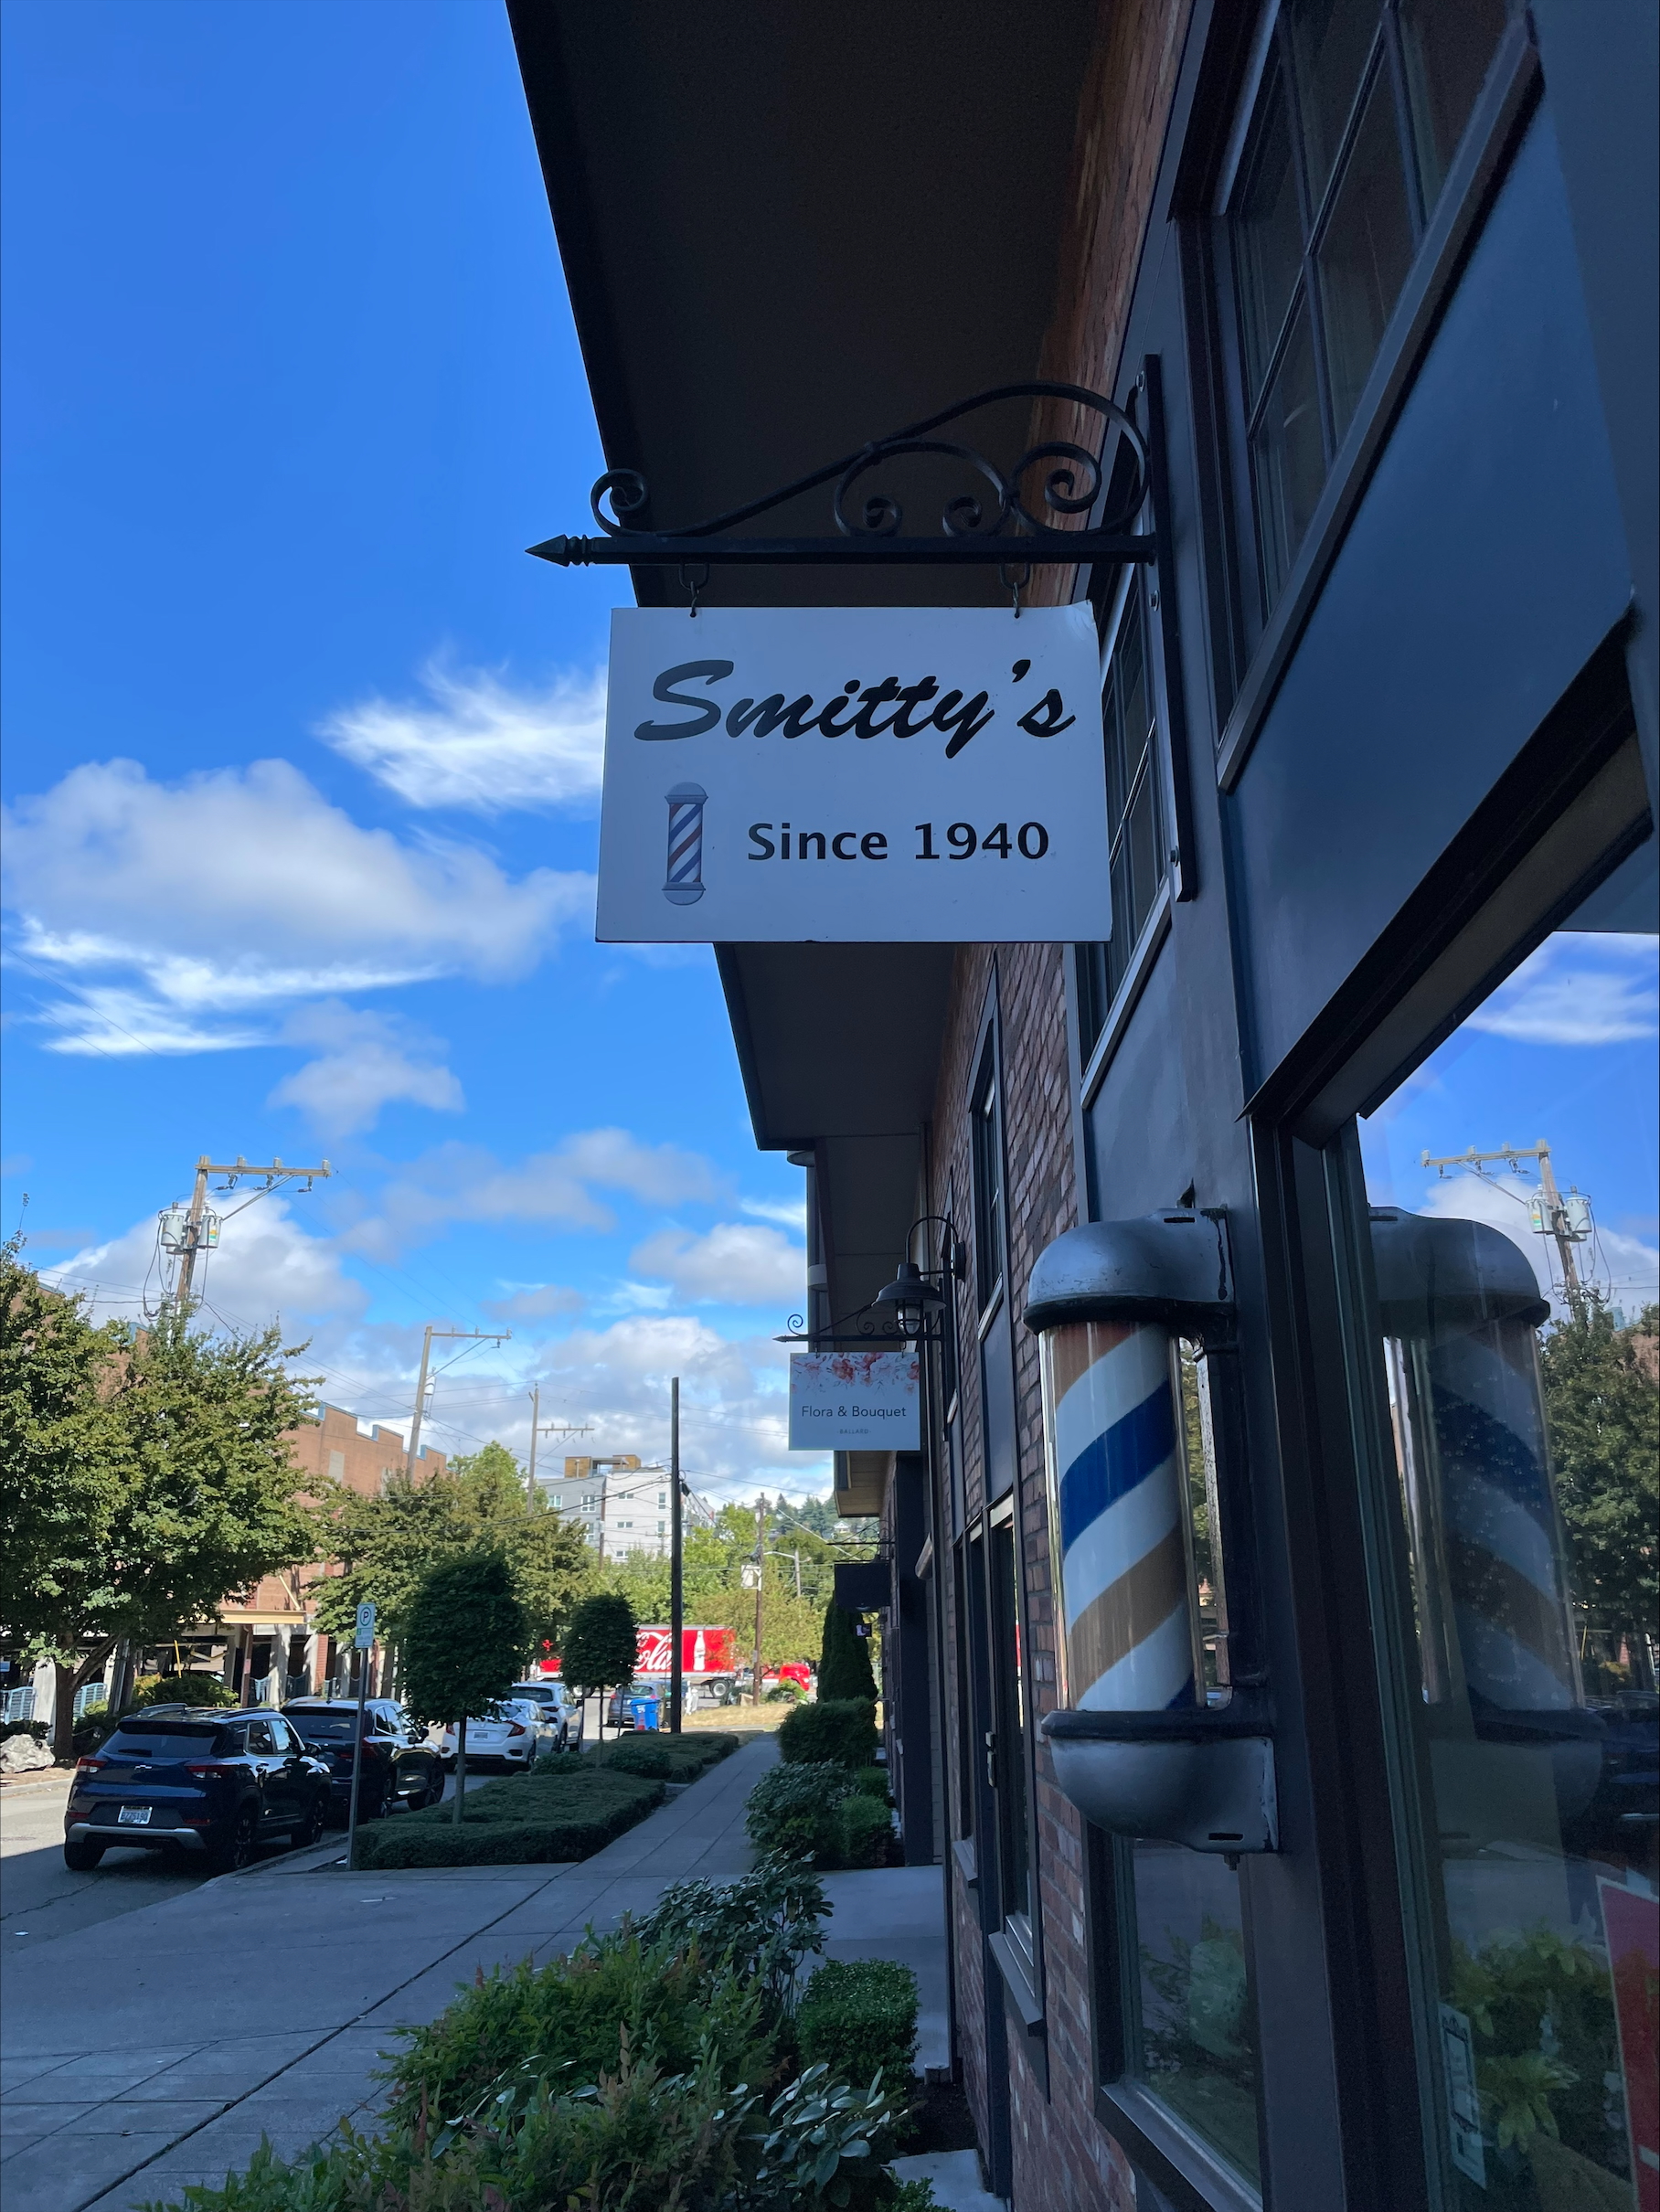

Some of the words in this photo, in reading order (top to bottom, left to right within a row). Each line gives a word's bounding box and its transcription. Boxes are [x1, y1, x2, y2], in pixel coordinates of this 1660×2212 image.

[633, 659, 1076, 758] Smitty's
[748, 822, 888, 860] Since
[915, 822, 1049, 860] 1940
[802, 1406, 833, 1417] Flora
[837, 1405, 847, 1417] &
[852, 1405, 907, 1420] Bouquet
